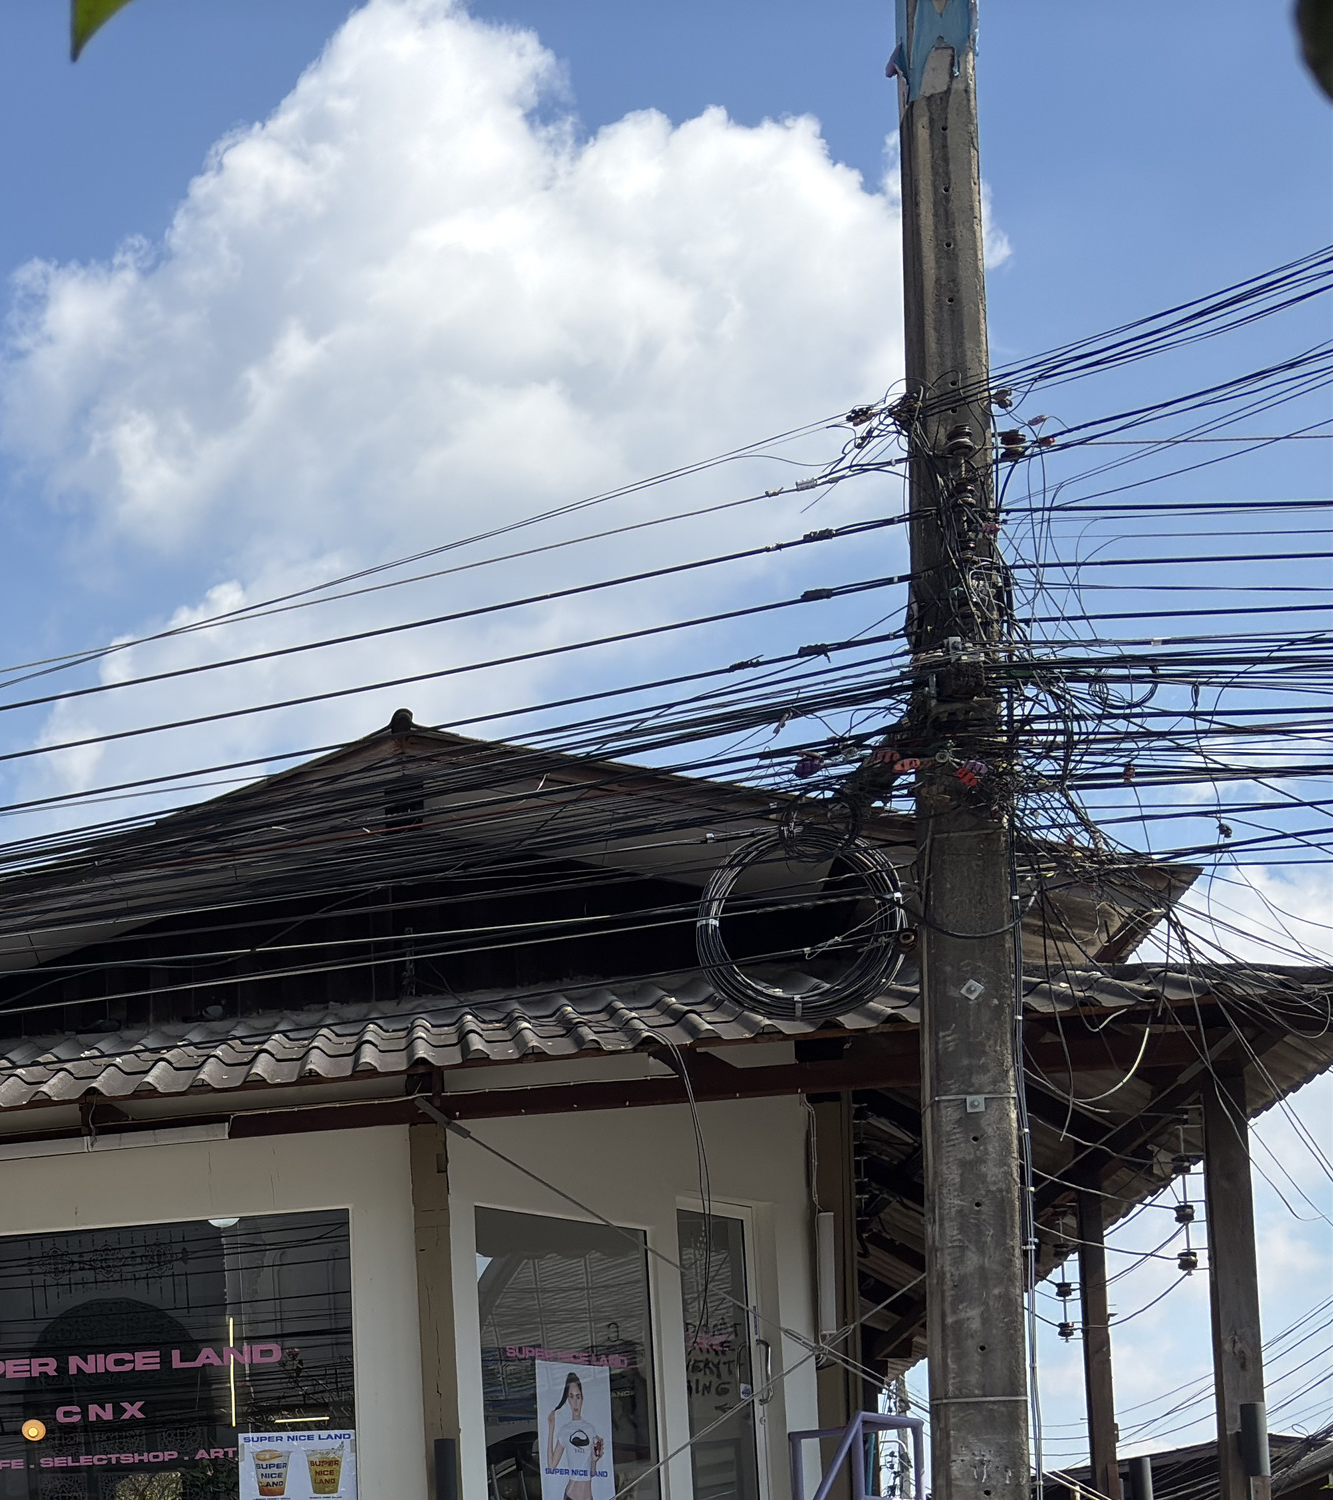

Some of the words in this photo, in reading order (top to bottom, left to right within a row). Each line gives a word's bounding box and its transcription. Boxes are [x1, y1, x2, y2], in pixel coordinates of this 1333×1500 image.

[68, 1351, 161, 1375] NICE
[171, 1343, 282, 1369] LAND
[55, 1401, 146, 1423] CNX
[243, 1435, 283, 1443] SUPER
[39, 1451, 178, 1469] SELECTSHOP
[194, 1447, 236, 1460] ART
[545, 1468, 570, 1476] SUPER
[571, 1469, 588, 1477] NICE
